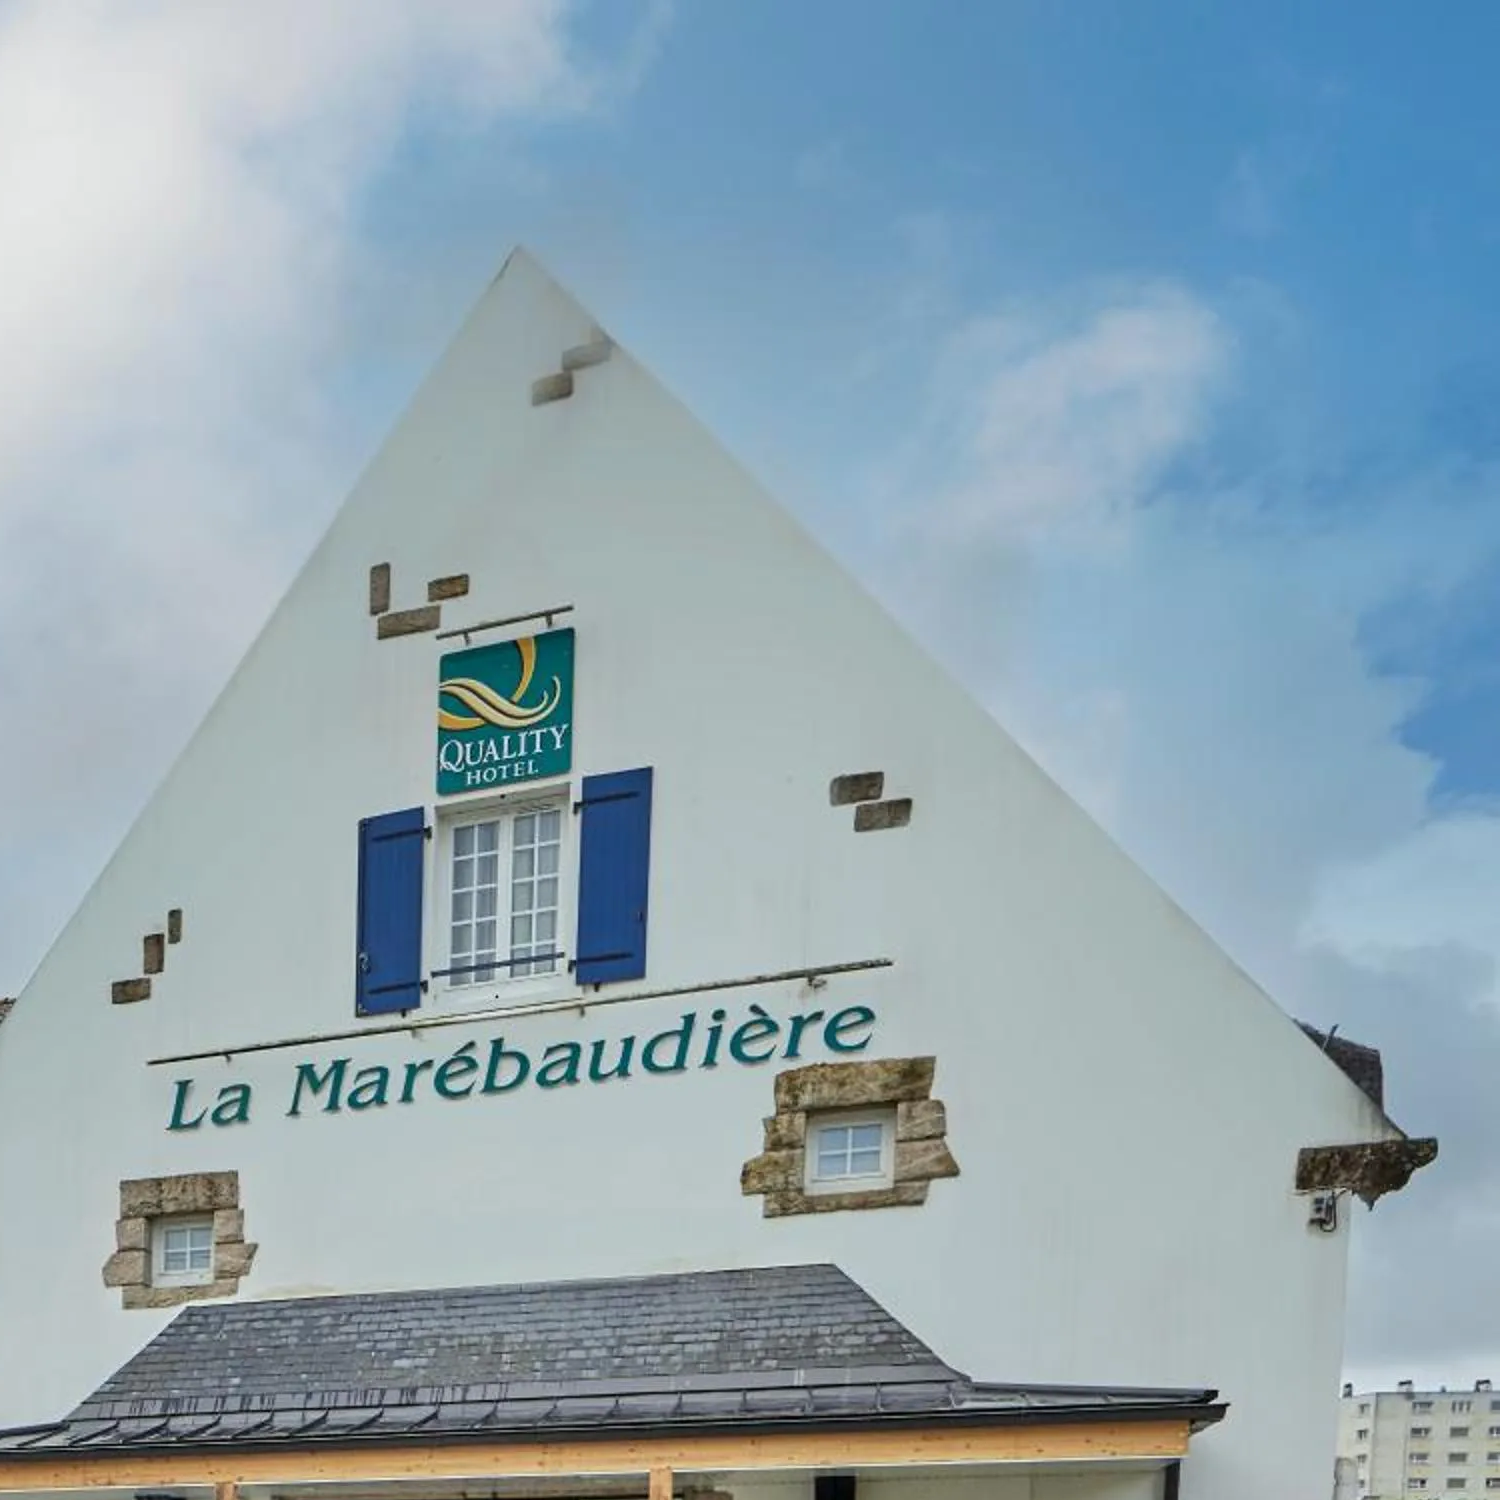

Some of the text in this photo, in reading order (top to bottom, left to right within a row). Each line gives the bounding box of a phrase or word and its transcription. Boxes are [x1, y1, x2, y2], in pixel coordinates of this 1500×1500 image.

[440, 723, 569, 772] QUALITY
[466, 760, 539, 786] HOTEL
[165, 1004, 876, 1131] La Marébaudière
